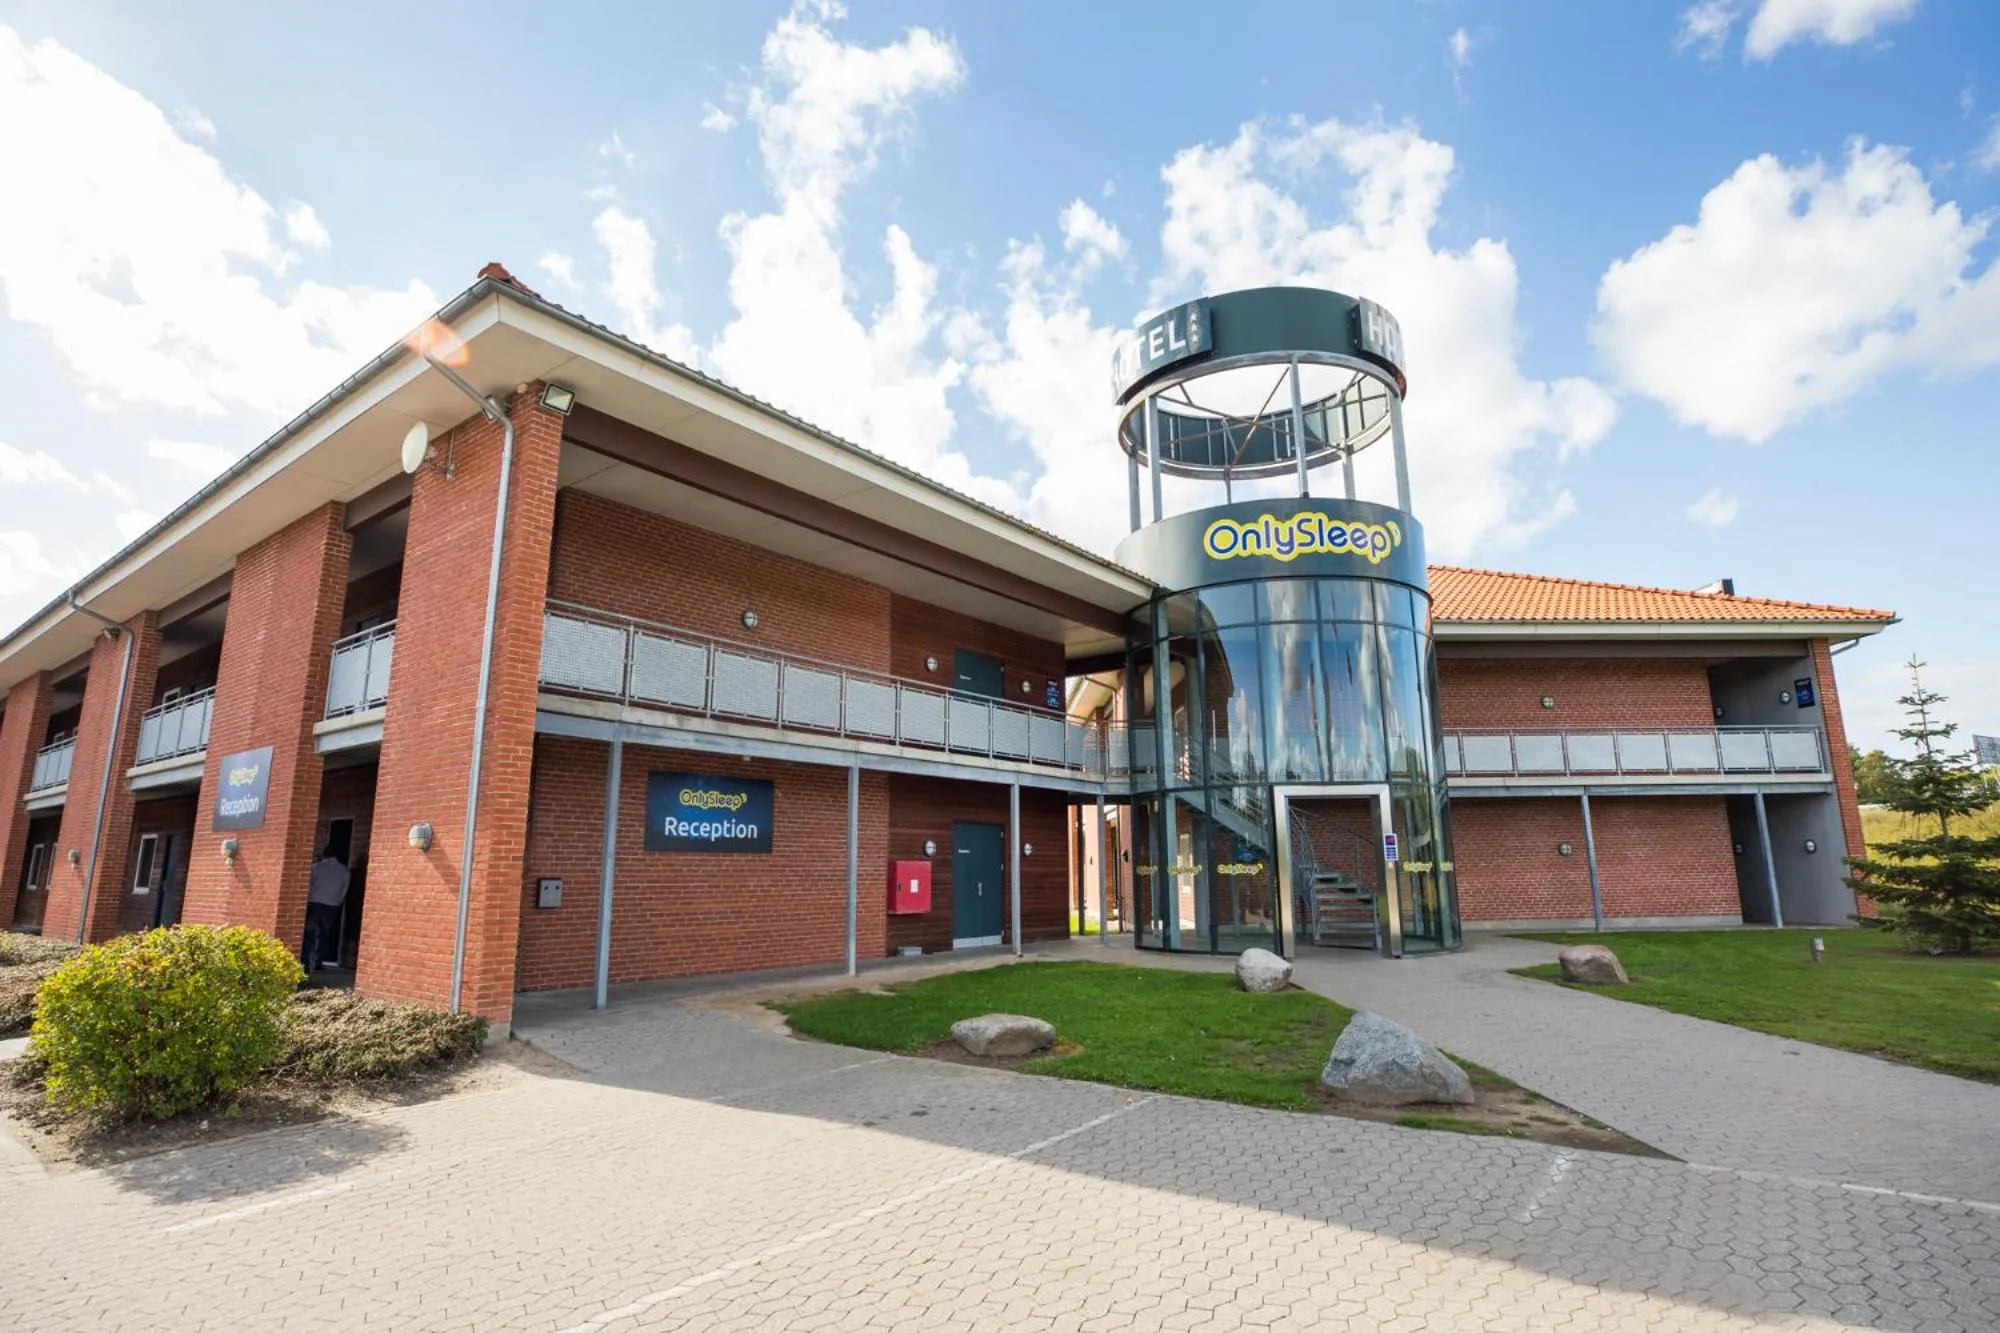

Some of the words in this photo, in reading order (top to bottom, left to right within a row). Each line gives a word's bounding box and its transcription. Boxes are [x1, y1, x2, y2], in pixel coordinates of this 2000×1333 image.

[1206, 514, 1391, 562] OnlySleep
[680, 789, 742, 811] OnlySleep
[664, 816, 758, 841] Reception
